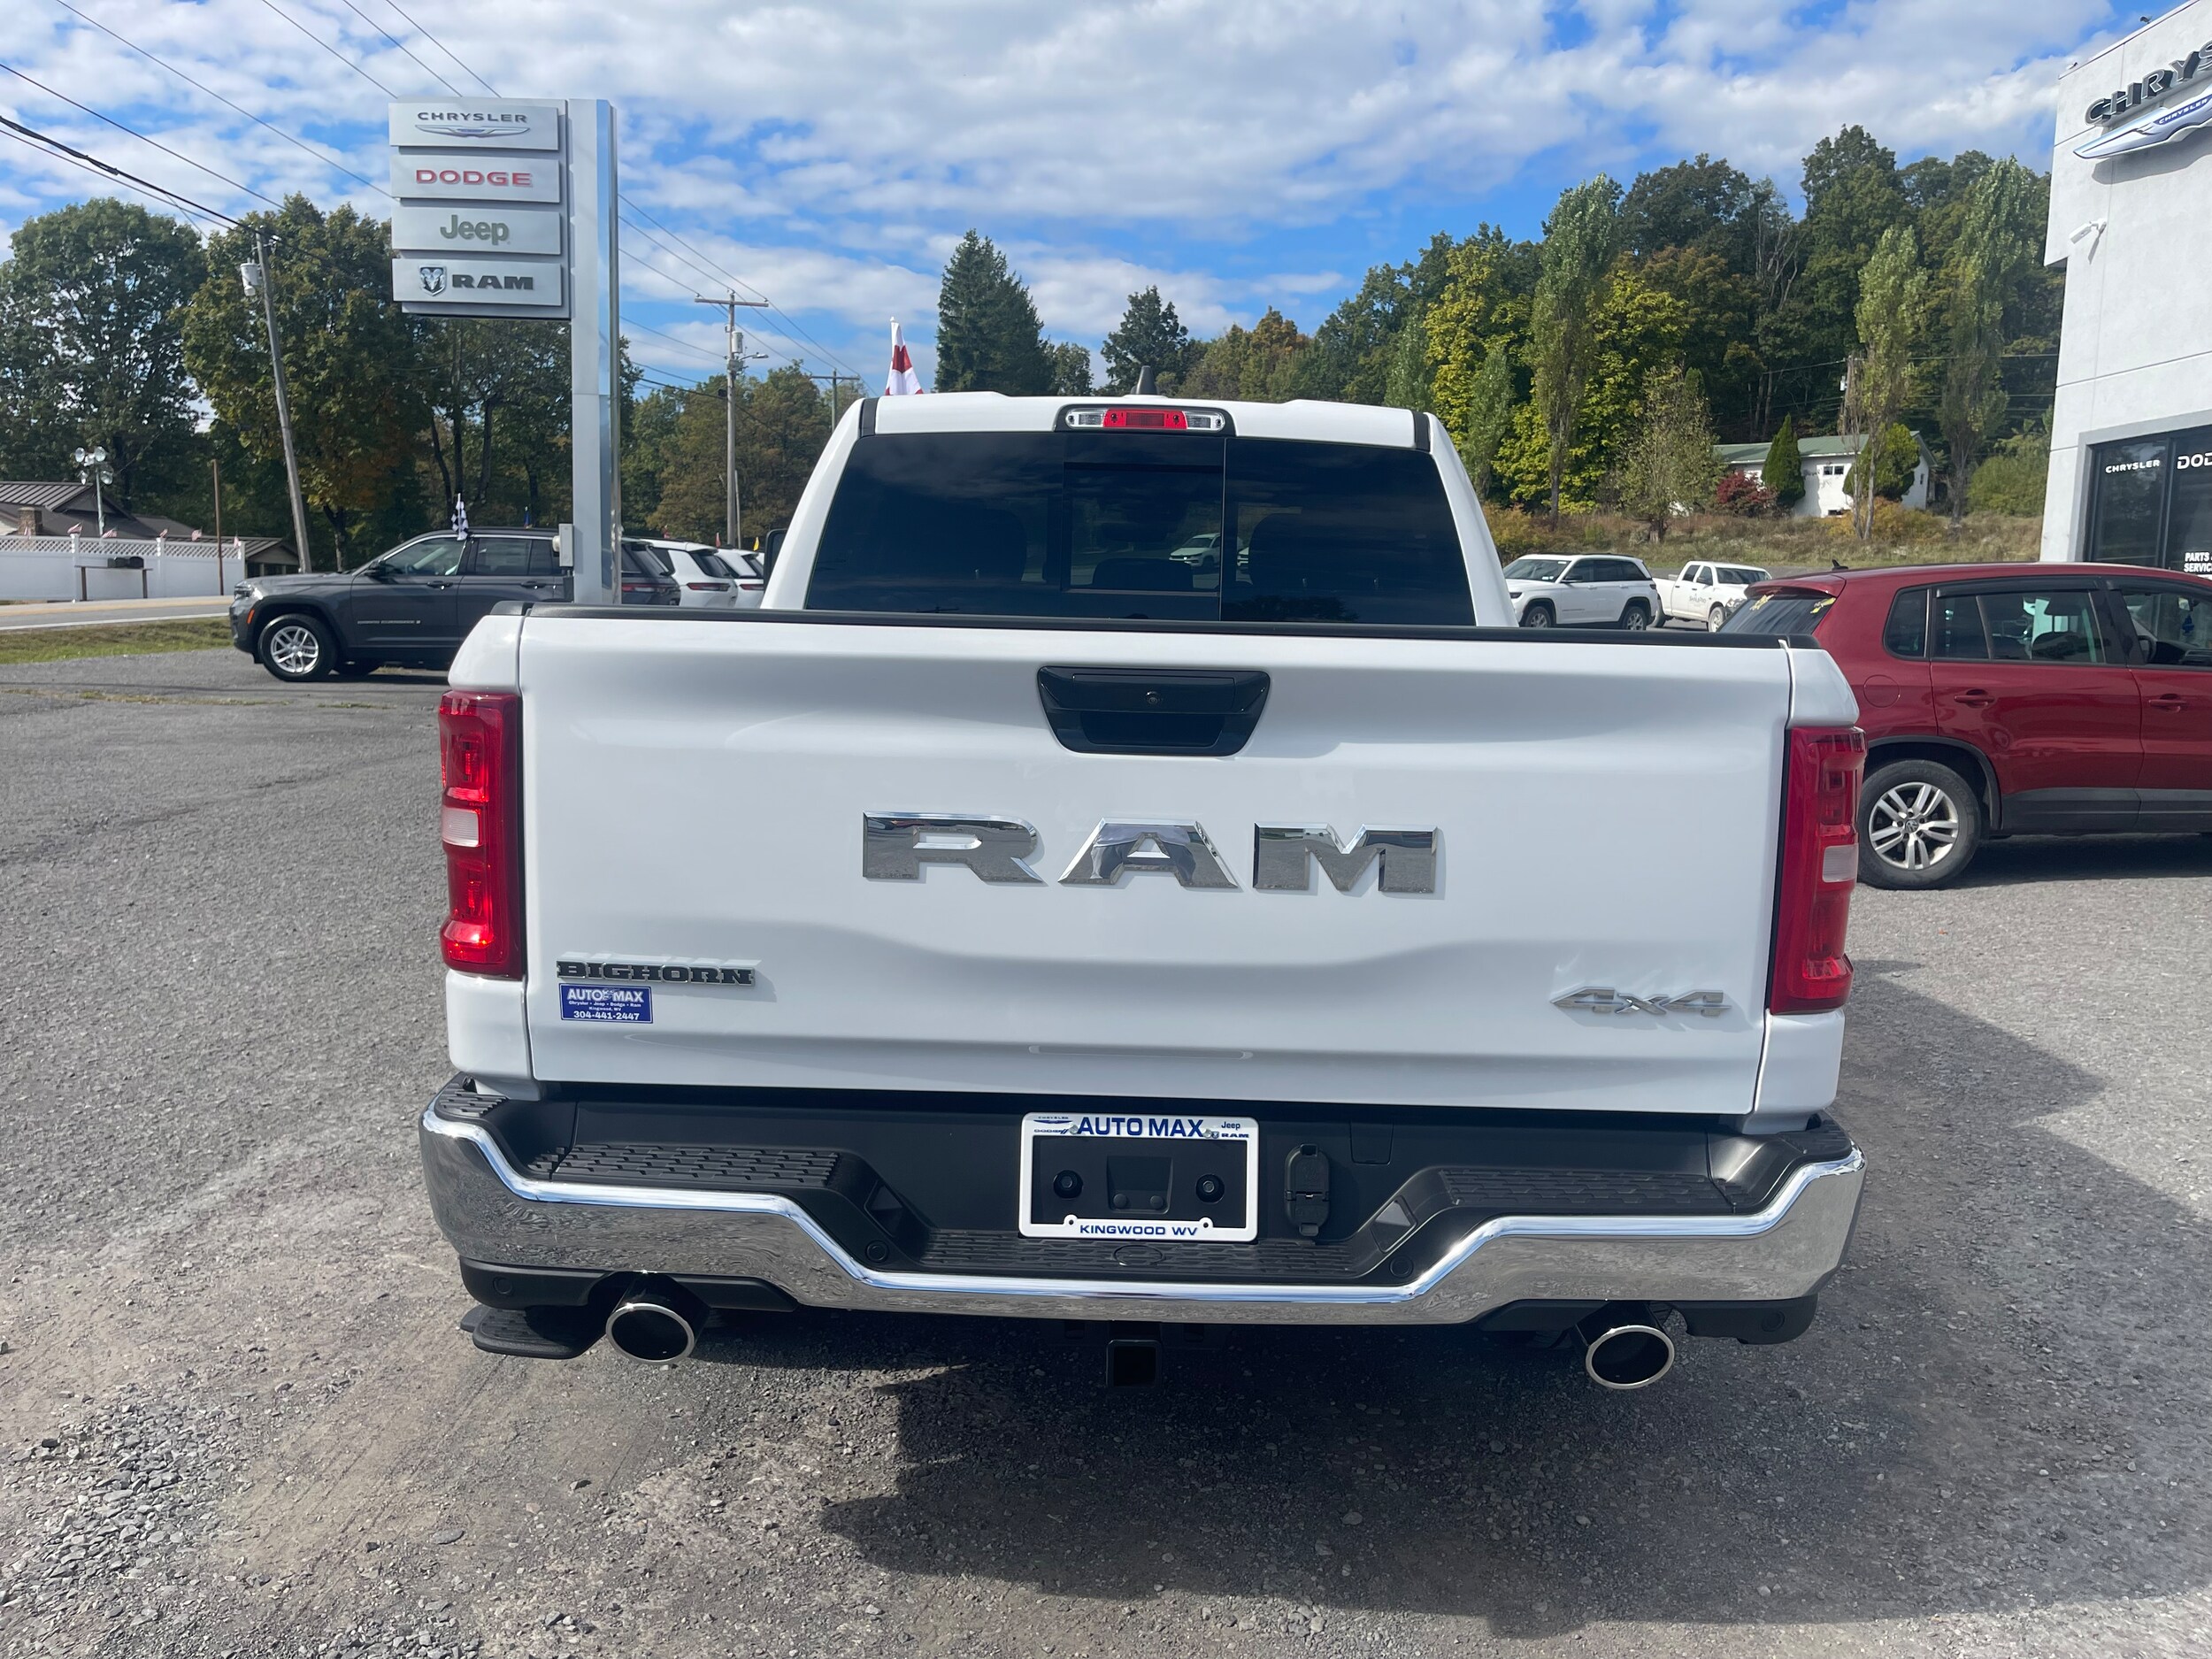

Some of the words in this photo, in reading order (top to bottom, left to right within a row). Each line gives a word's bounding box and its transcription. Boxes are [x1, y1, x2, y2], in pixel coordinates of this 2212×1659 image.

[418, 111, 527, 123] CHRYSLER
[2159, 98, 2208, 124] CHRYSLER
[416, 169, 533, 187] DODGE
[440, 214, 510, 245] Jeep
[452, 274, 534, 290] RAM
[2105, 459, 2161, 473] CHRYSLER
[2185, 552, 2209, 562] PARTS
[862, 811, 1440, 894] RAM
[557, 960, 755, 987] BIGHORN
[567, 988, 602, 1002] AUTO
[612, 990, 644, 1002] MAX
[573, 1010, 640, 1020] 304-441-2447
[1077, 1117, 1142, 1136] AUTO
[1149, 1118, 1203, 1138] MAX
[1221, 1121, 1240, 1131] Jeep
[1079, 1225, 1165, 1235] KINGWOOD
[1171, 1227, 1197, 1236] WV
